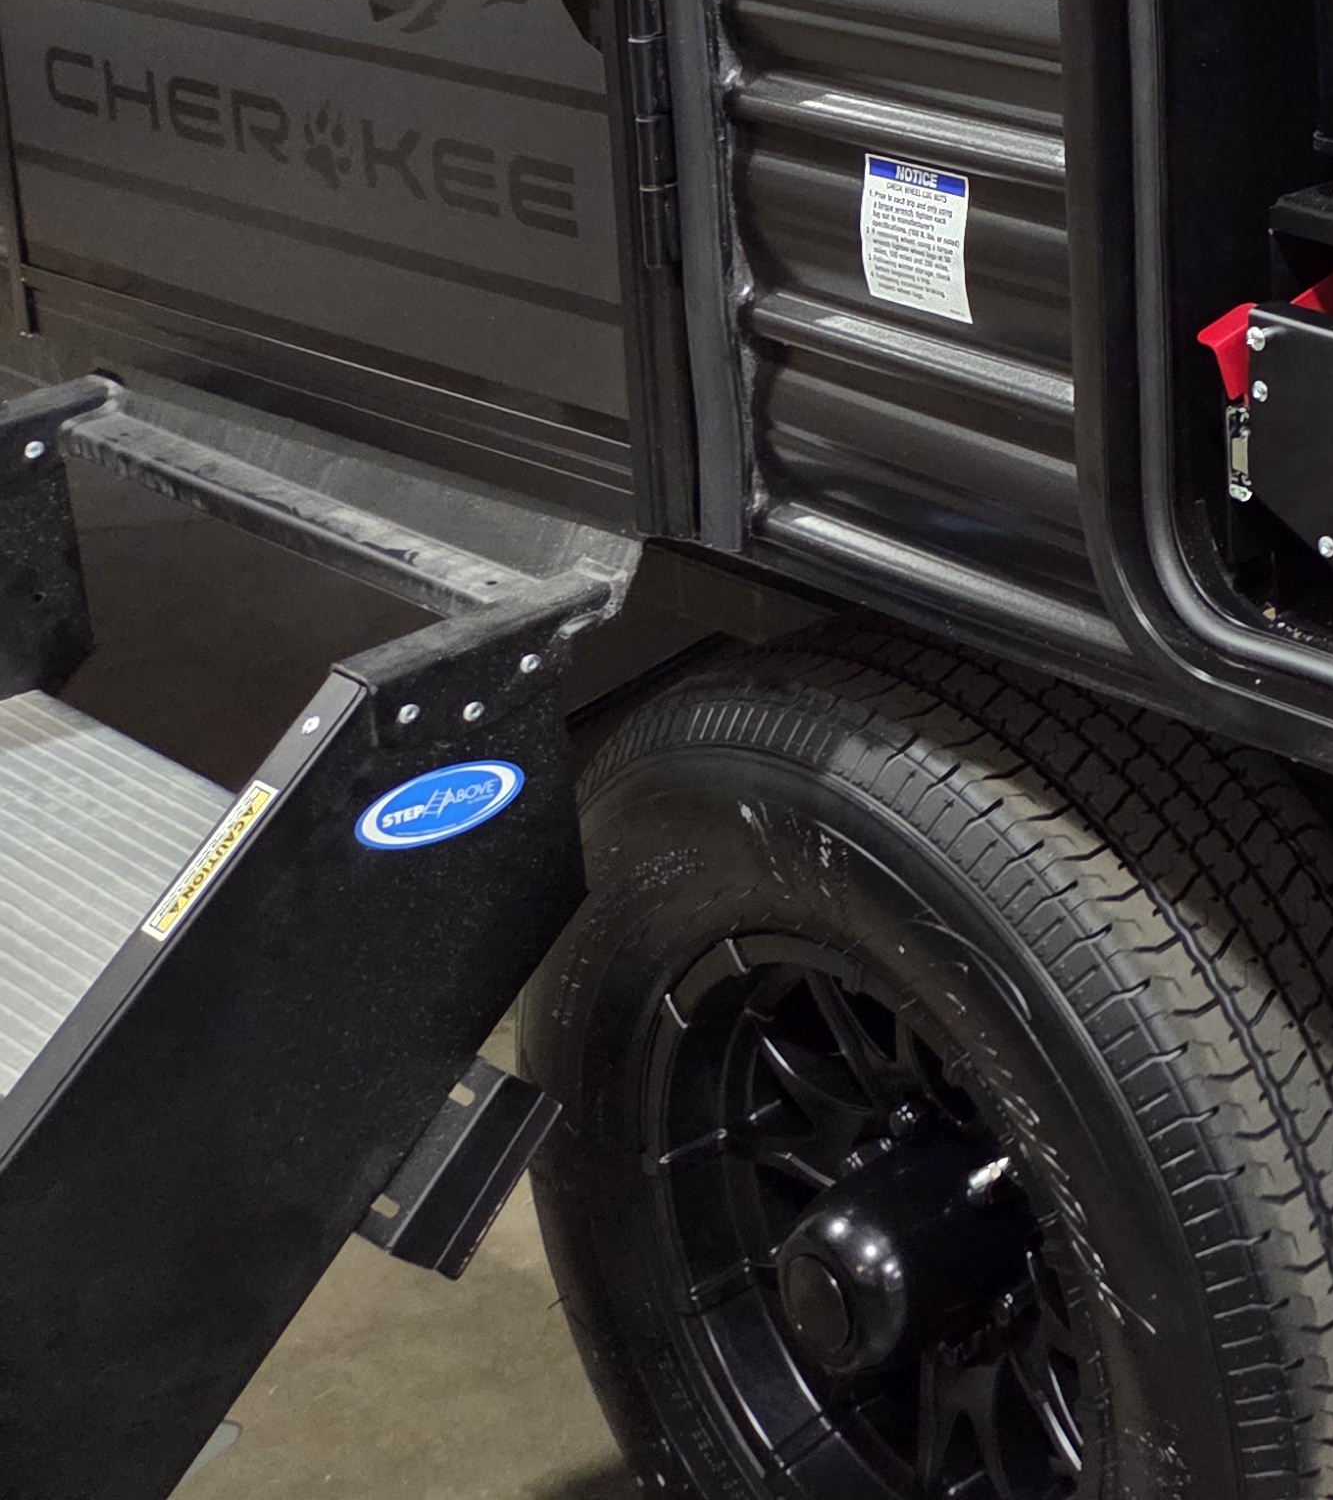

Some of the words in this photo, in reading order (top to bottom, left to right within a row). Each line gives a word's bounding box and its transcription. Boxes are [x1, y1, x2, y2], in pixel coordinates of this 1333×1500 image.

[895, 166, 938, 188] NOTICE
[381, 804, 426, 829] STEP
[444, 779, 496, 807] ABOVE
[182, 820, 245, 899] CAUTION
